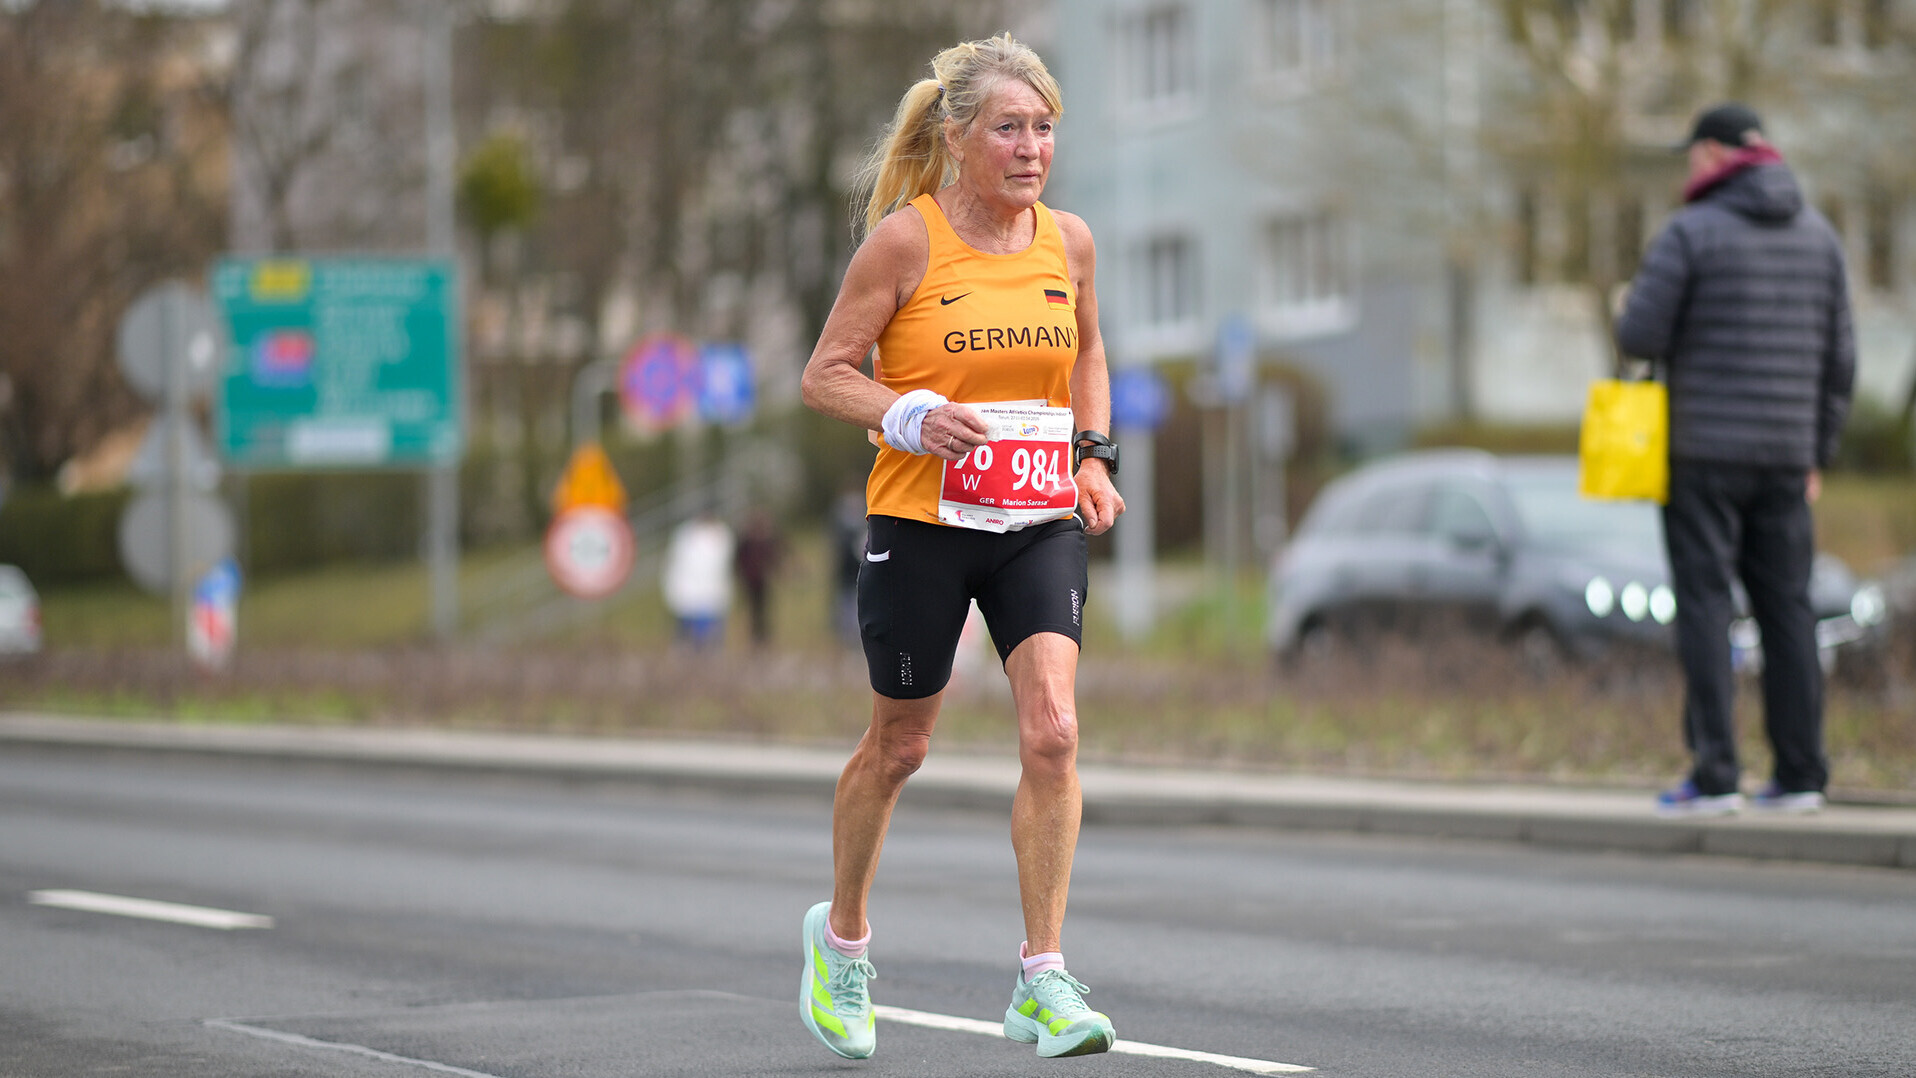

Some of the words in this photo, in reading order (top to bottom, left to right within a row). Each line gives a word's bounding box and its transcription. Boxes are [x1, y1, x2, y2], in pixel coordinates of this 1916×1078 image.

[944, 326, 1077, 353] GERMANY
[1011, 448, 1061, 491] 984
[962, 473, 982, 491] W
[979, 497, 995, 505] GER
[1002, 498, 1026, 506] Marion
[985, 517, 1004, 526] ANIRO
